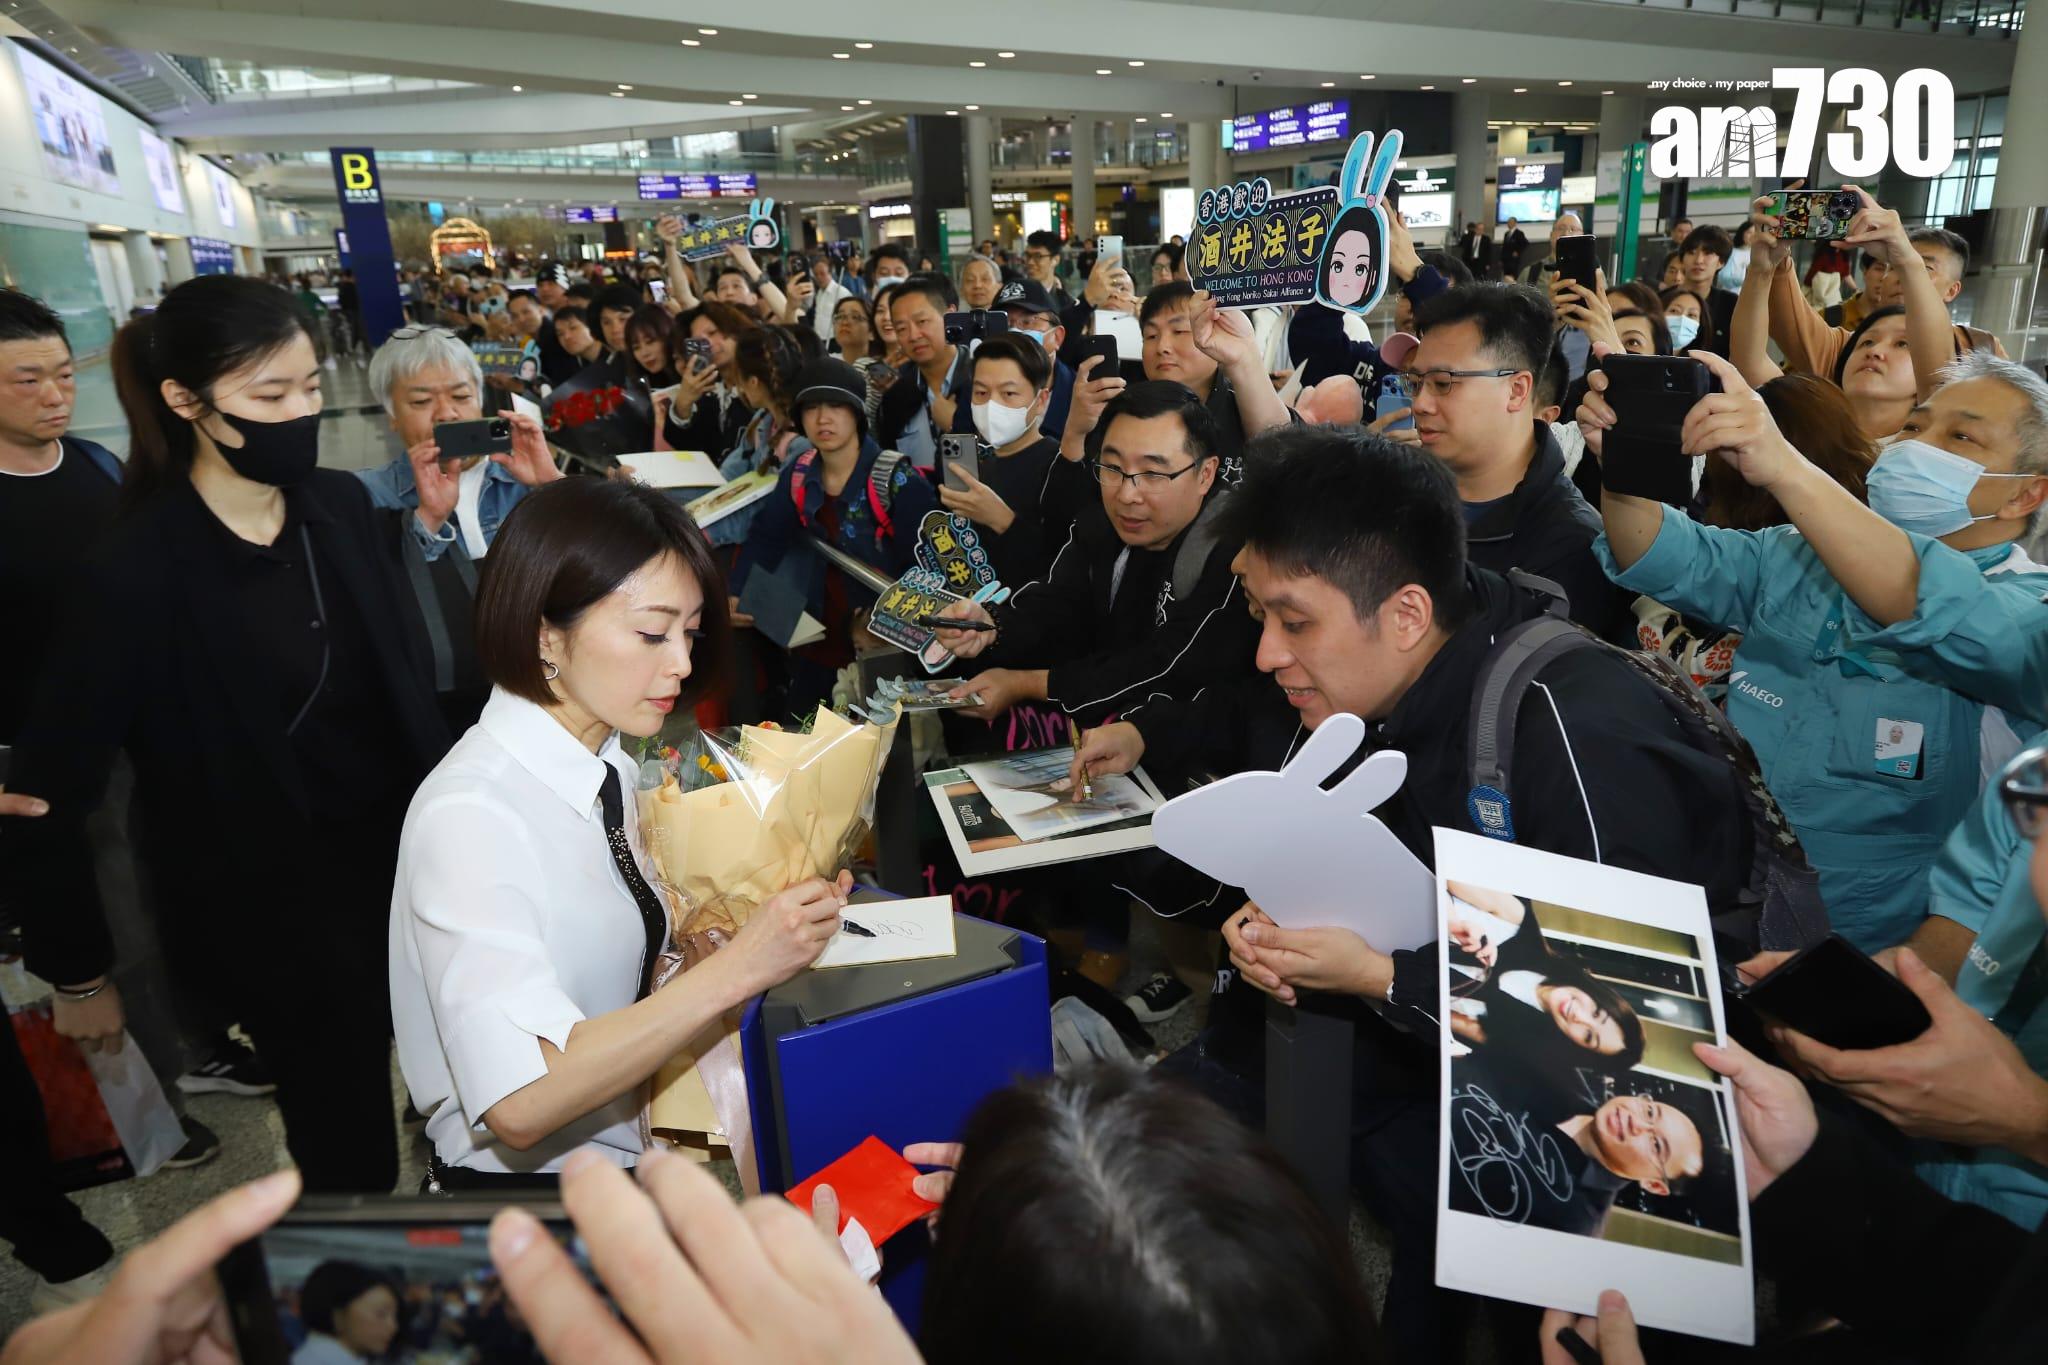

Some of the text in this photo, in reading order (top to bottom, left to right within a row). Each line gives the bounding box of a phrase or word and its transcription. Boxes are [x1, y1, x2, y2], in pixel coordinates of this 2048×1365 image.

[341, 153, 373, 190] B
[1199, 184, 1266, 218] 香港歡迎
[1200, 213, 1324, 268] 酒井法子
[1204, 269, 1314, 291] WELCOME TO HONG KONG
[1226, 291, 1241, 303] Kong
[1242, 289, 1261, 300] Noriko
[1263, 287, 1279, 298] Sakai
[1280, 286, 1304, 297] Alliance
[932, 526, 971, 586] 酒井
[1737, 679, 1784, 710] HAECO
